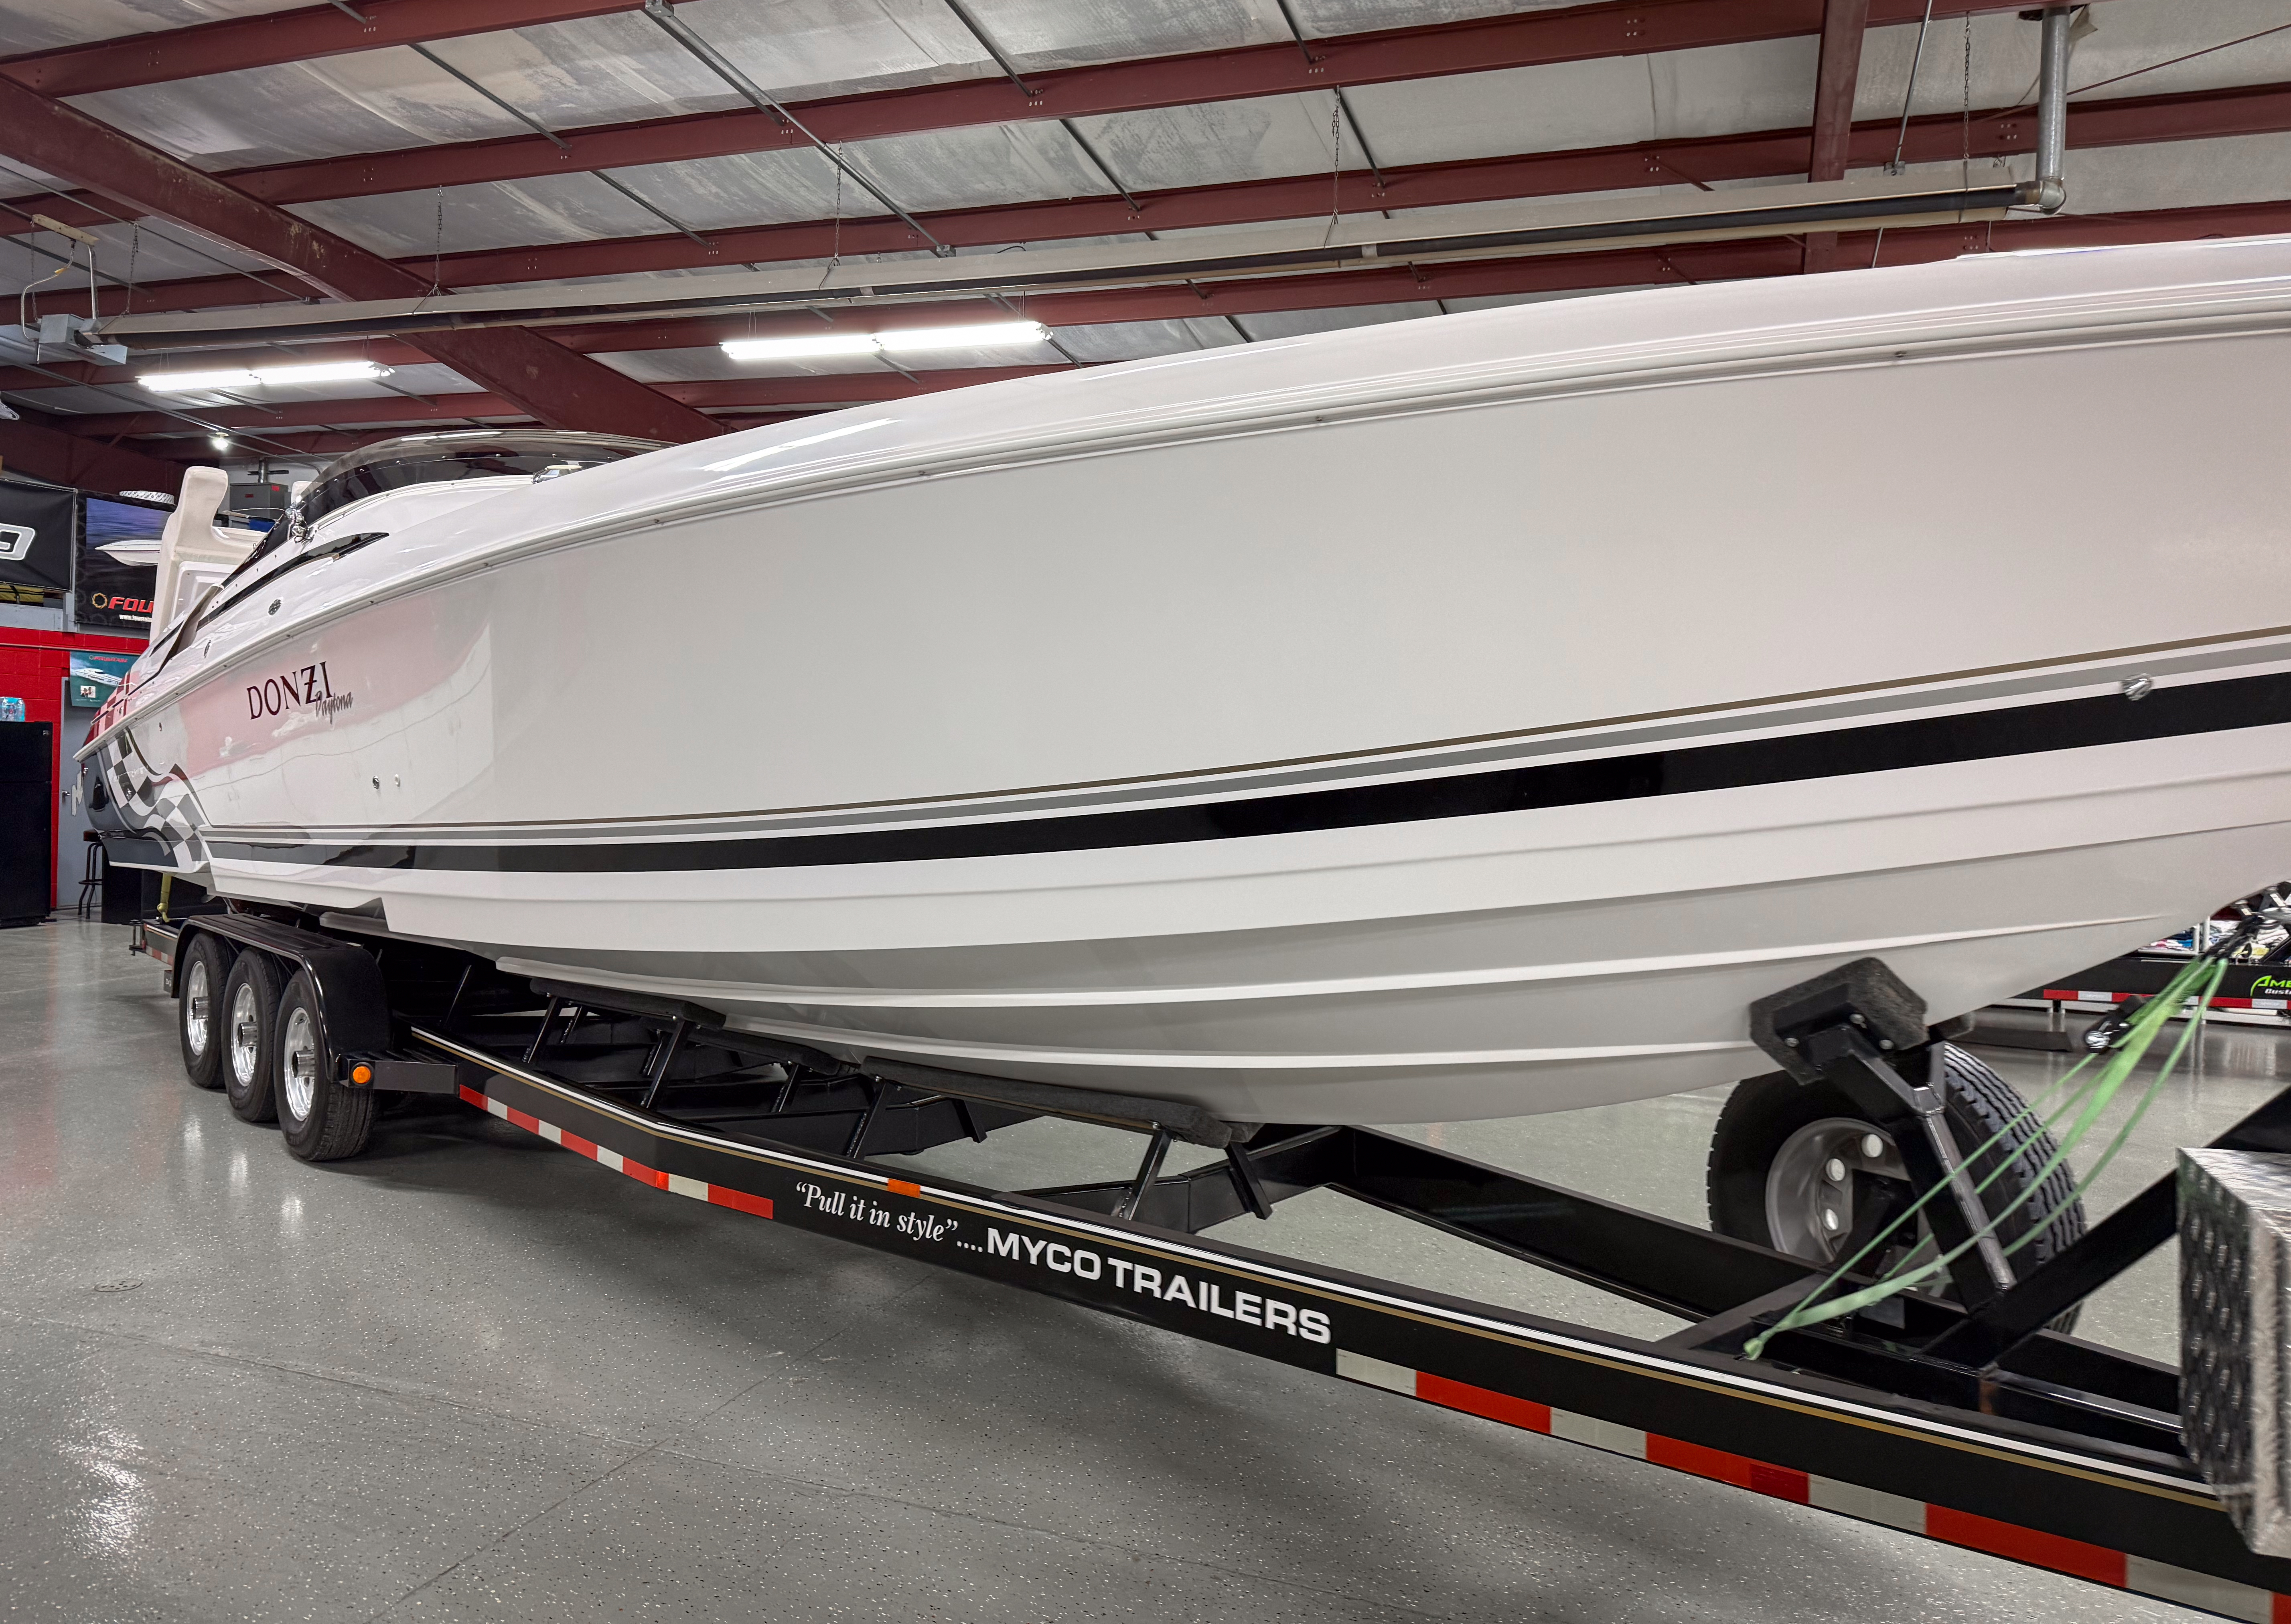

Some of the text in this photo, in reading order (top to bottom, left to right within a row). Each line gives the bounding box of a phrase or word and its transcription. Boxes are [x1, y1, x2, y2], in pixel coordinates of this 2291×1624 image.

[246, 661, 333, 720] DONZI
[315, 690, 353, 725] Daytona
[849, 1196, 866, 1221] it
[869, 1201, 890, 1228] in
[1107, 1257, 1331, 1344] TRAILERS
